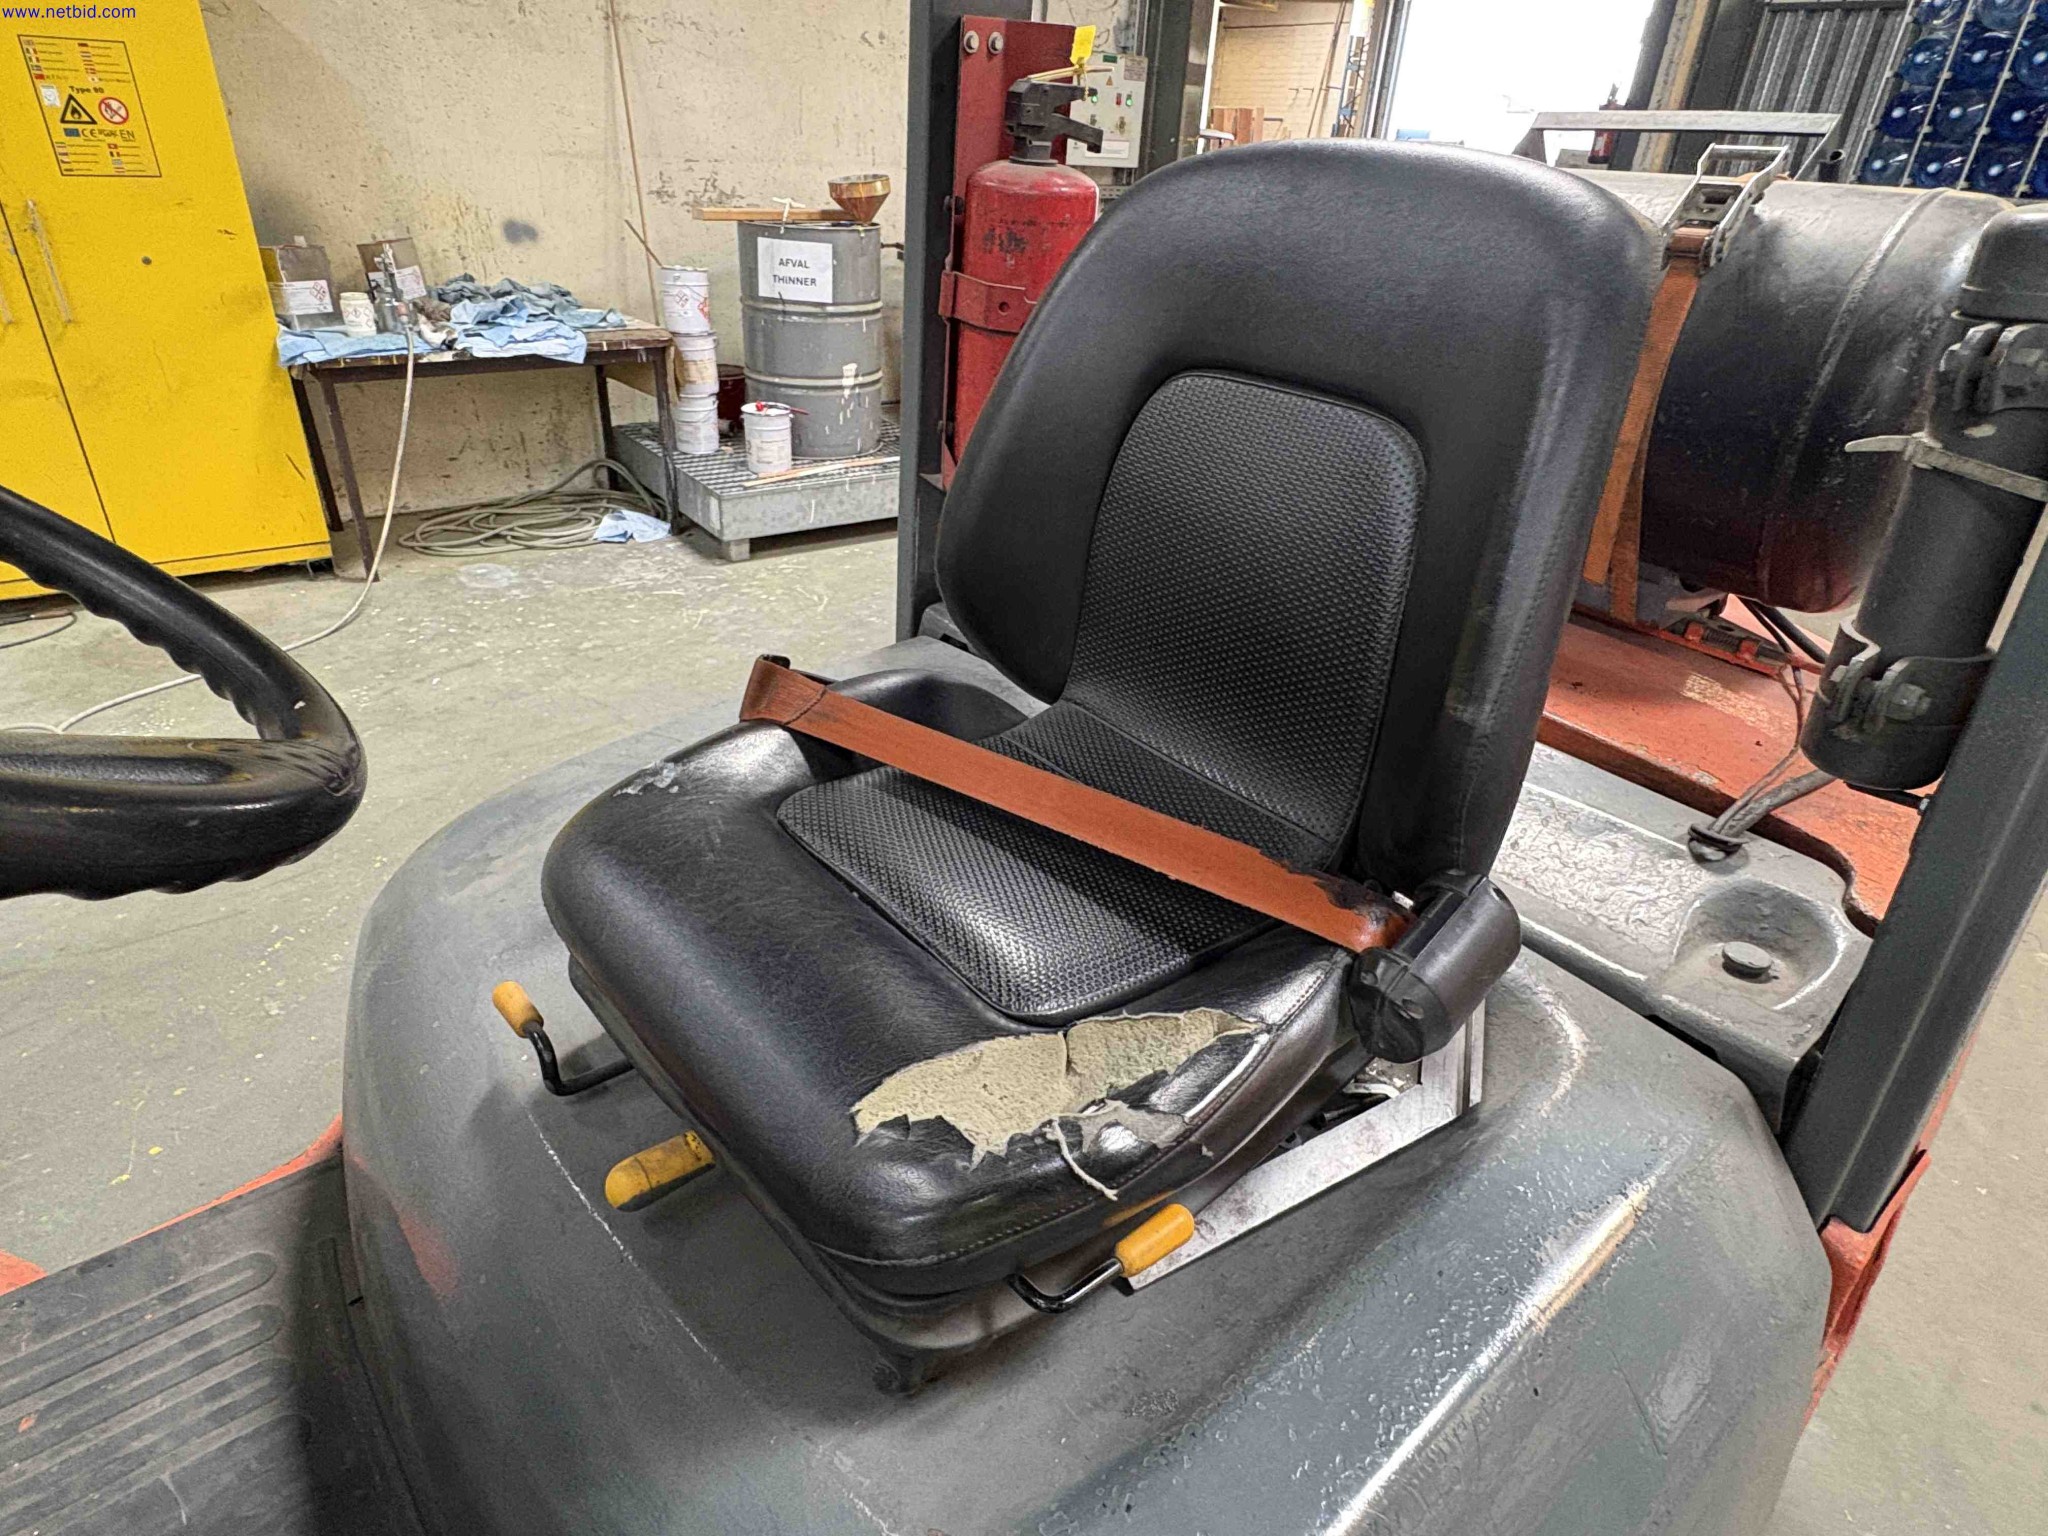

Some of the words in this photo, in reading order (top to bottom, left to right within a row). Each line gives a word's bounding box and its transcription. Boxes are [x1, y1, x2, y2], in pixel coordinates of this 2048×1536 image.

[69, 85, 91, 94] Type
[778, 257, 811, 269] AFVAL
[772, 274, 817, 287] THINNER
